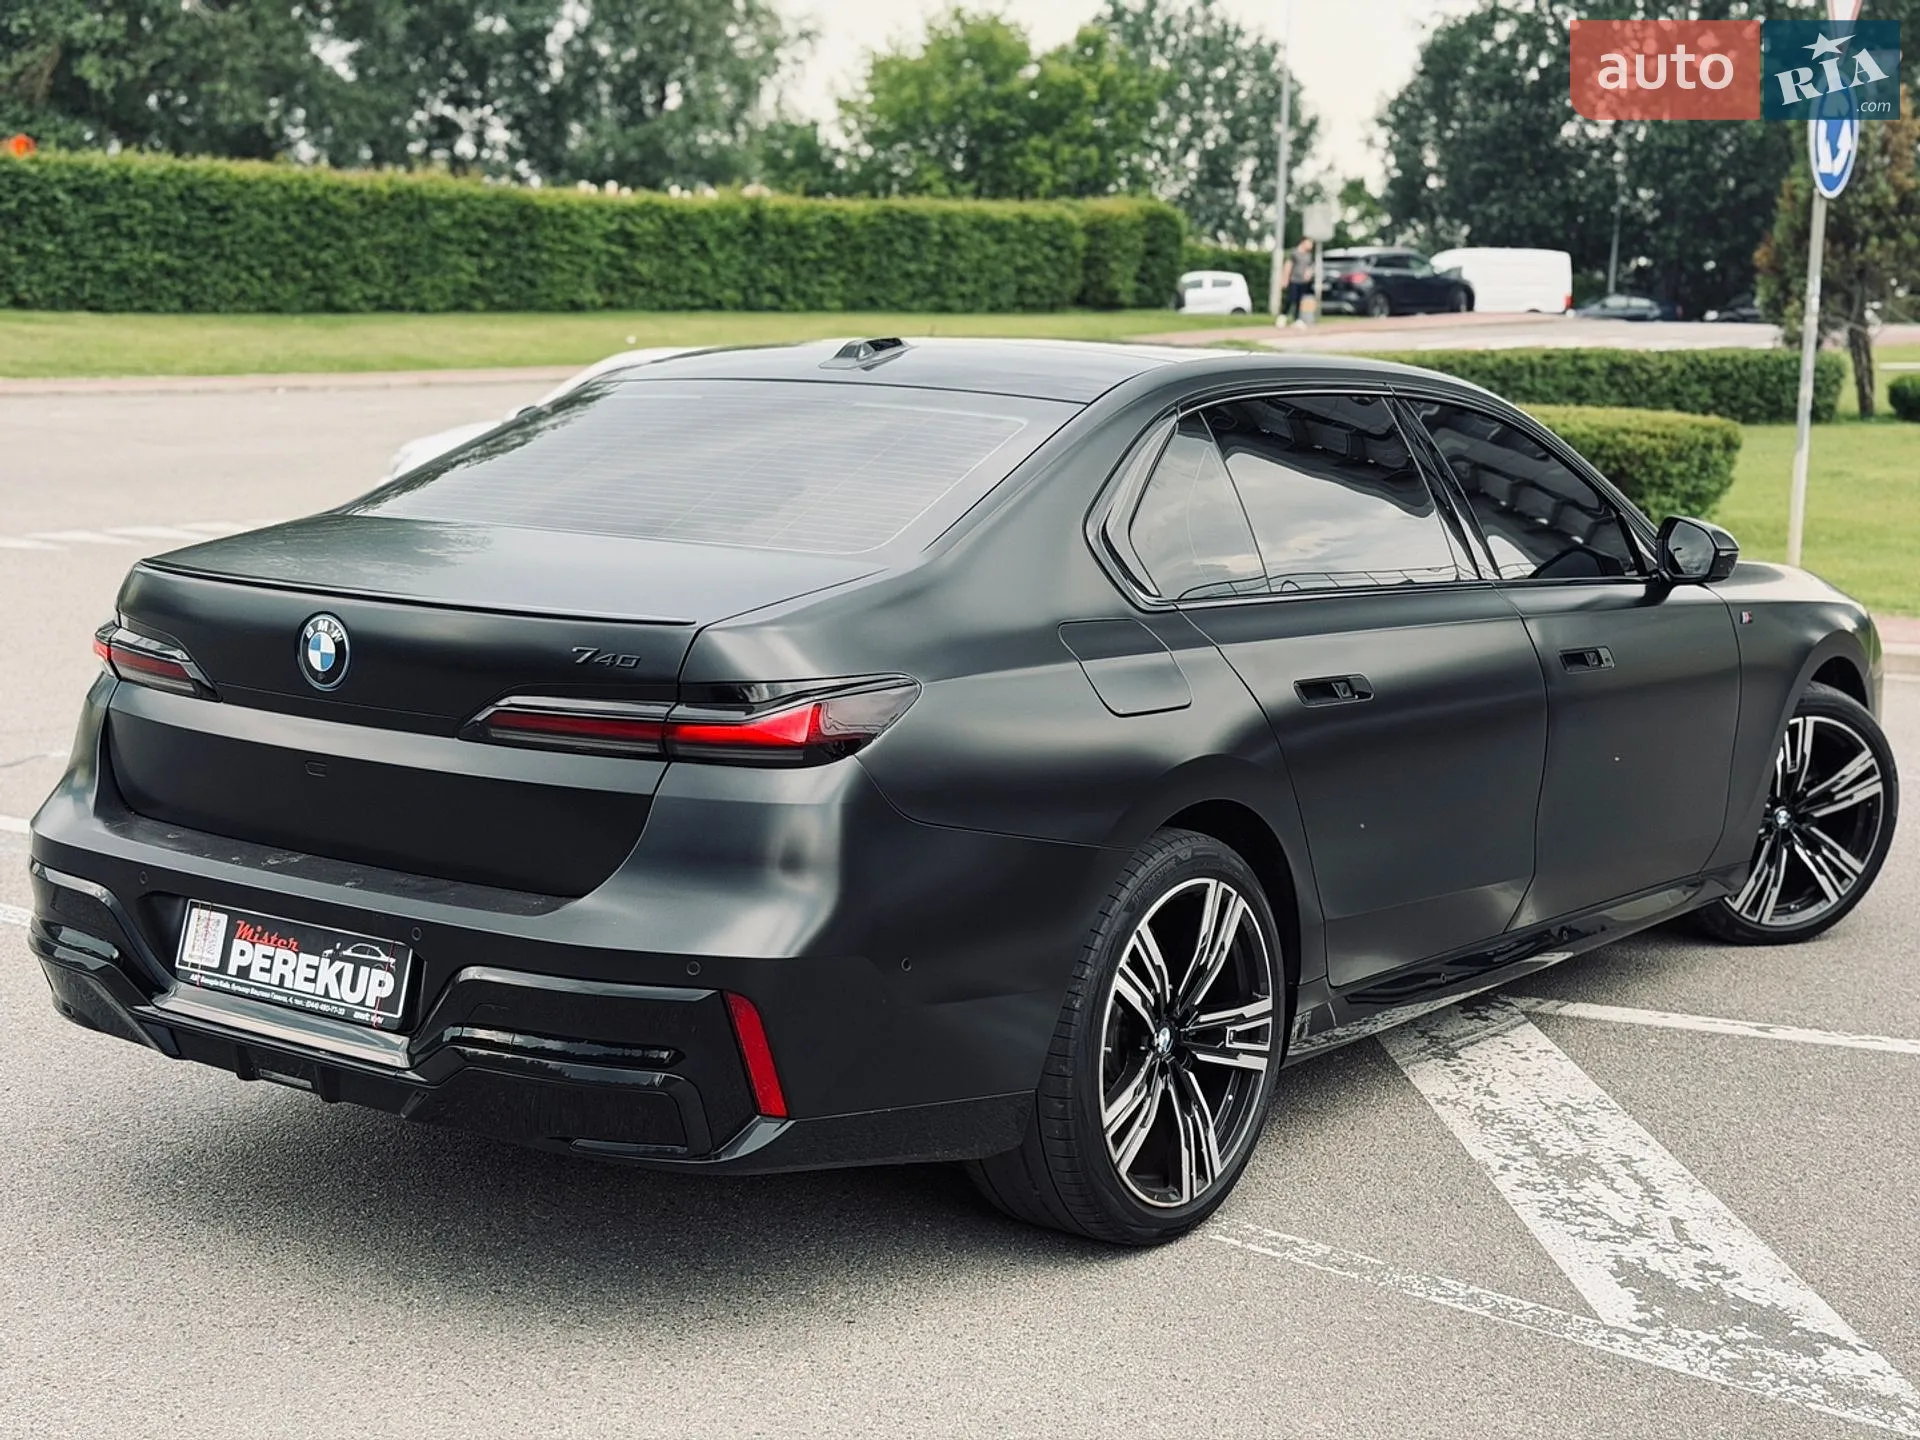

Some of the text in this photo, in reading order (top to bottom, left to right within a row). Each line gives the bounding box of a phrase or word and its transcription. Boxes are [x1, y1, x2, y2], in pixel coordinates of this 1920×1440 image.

[305, 619, 344, 644] BMW
[571, 646, 641, 668] 740
[235, 919, 300, 952] Mister
[227, 938, 395, 1010] PEREKUP
